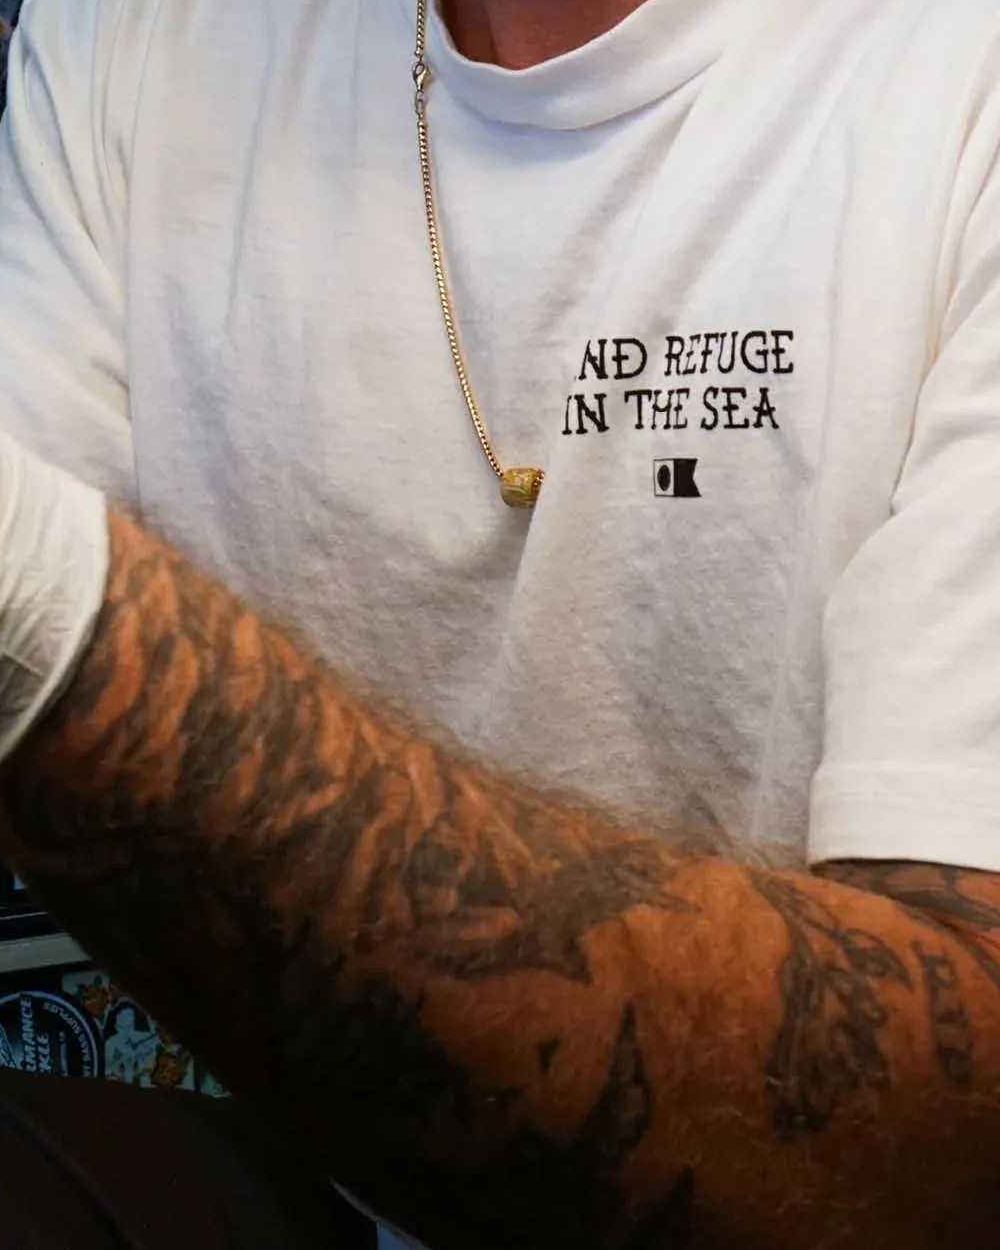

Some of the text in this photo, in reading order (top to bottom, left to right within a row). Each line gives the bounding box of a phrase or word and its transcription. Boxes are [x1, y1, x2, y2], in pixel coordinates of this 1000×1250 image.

[664, 330, 794, 377] REFUGE
[561, 386, 780, 435] IN THE SEA
